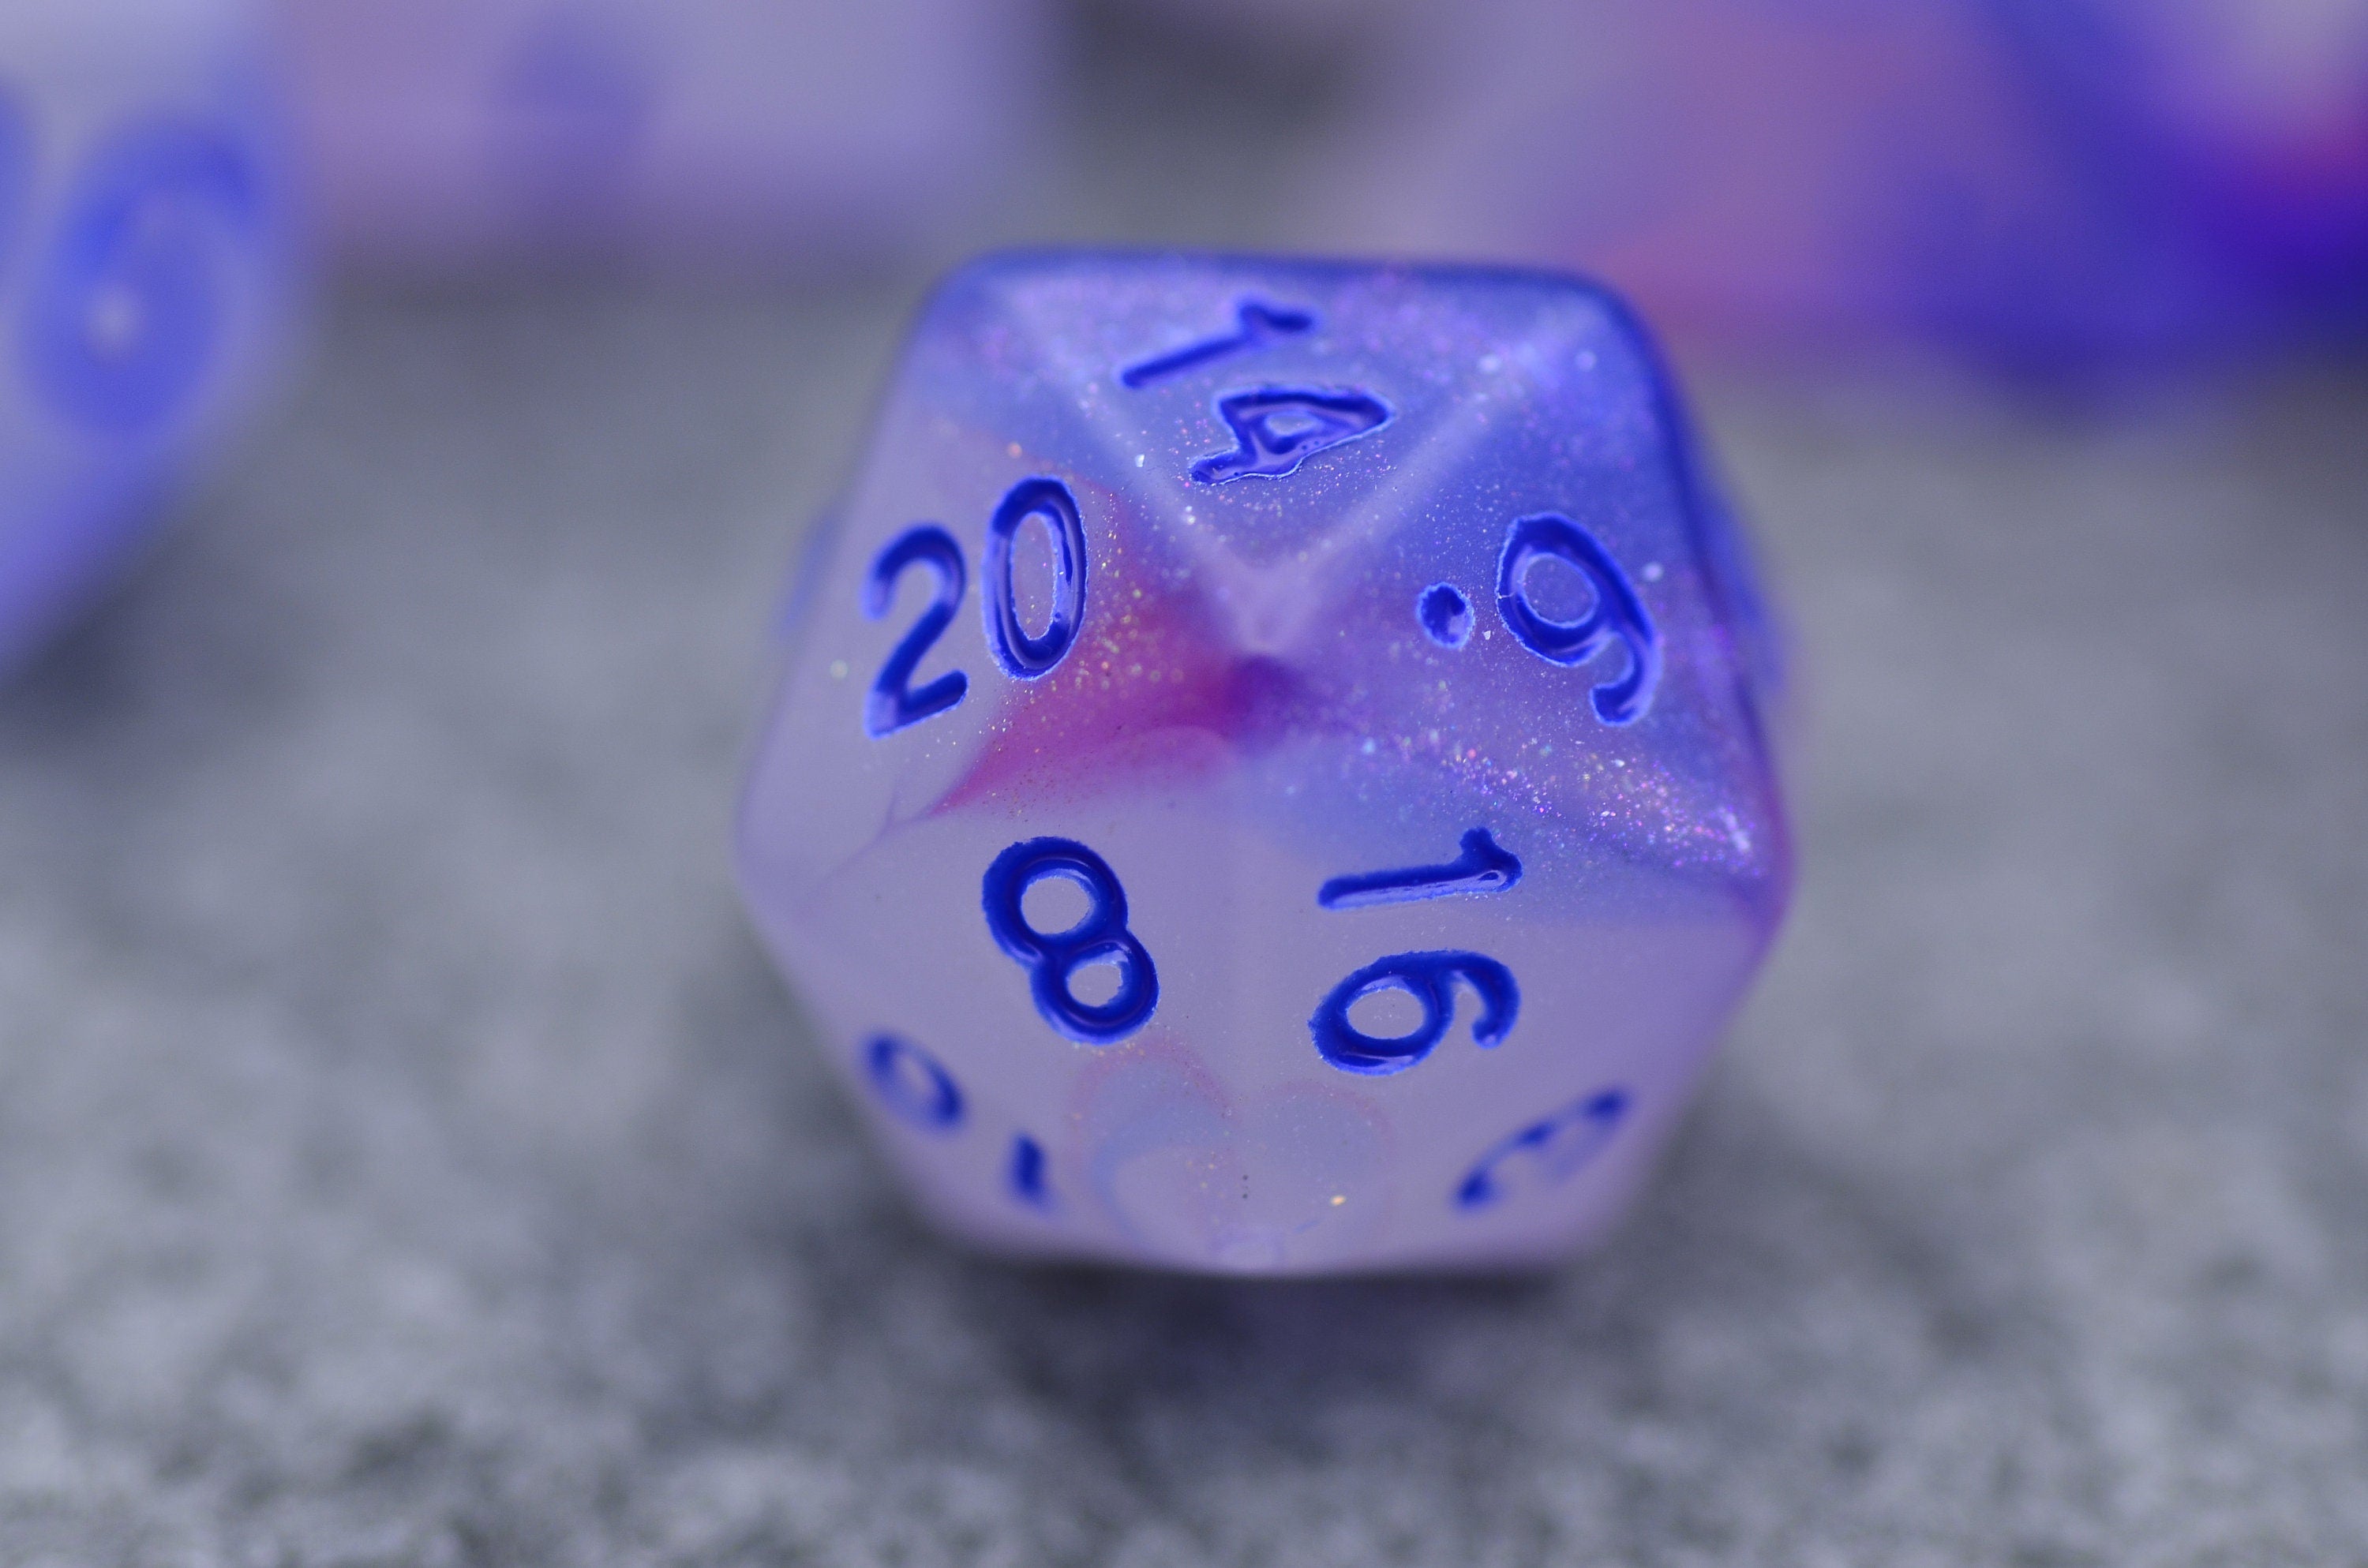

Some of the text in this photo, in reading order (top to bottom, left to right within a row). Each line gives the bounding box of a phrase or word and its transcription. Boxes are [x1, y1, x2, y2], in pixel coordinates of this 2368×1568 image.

[862, 475, 1088, 740] 20
[982, 835, 1160, 1046] 8
[1309, 827, 1522, 1078] 16
